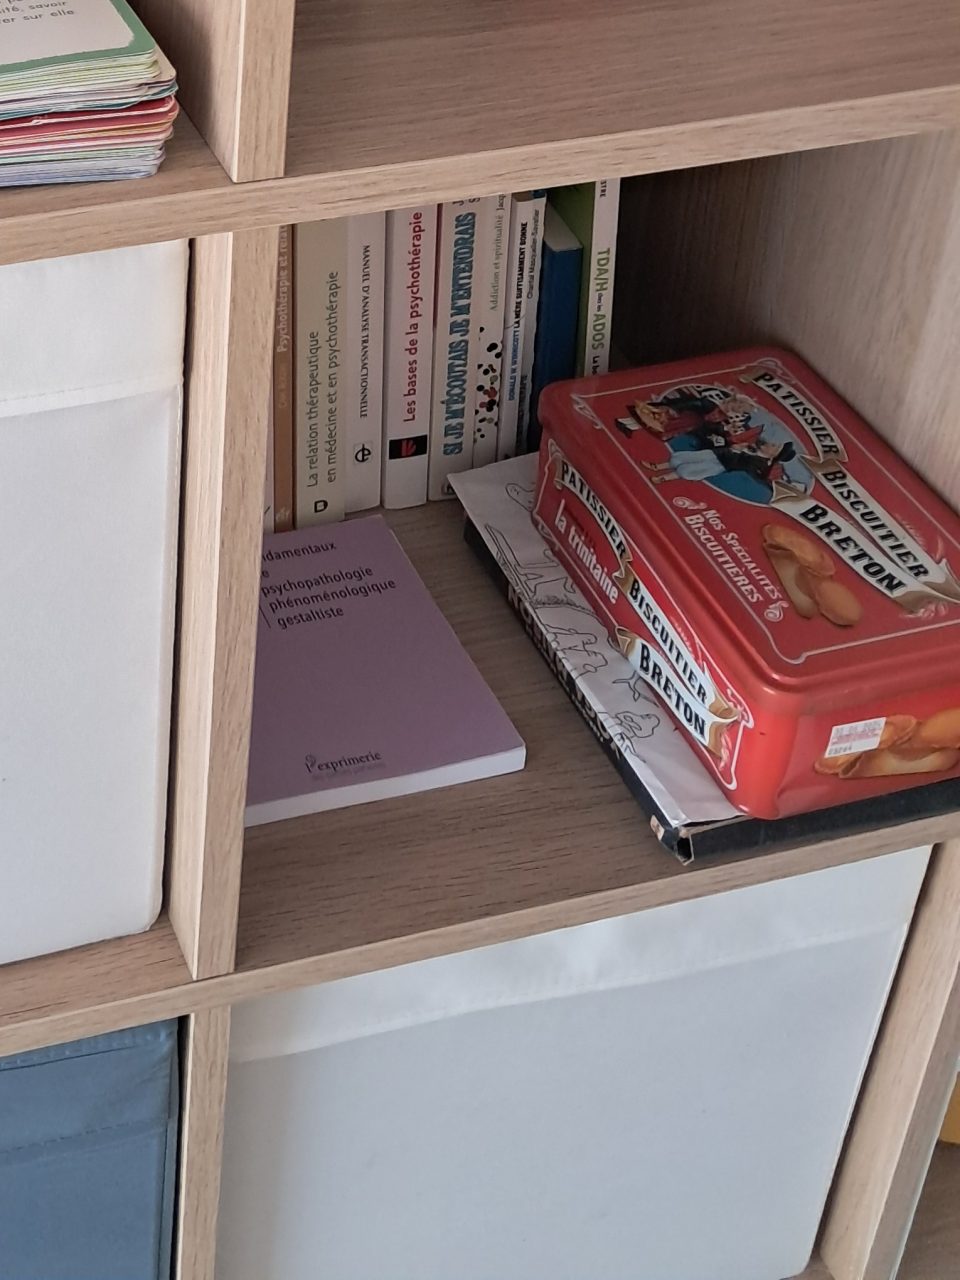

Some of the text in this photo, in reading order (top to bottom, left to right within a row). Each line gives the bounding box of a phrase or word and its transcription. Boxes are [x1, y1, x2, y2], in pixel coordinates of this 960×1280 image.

[23, 13, 44, 21] sur
[28, 1, 68, 10] savoir
[490, 213, 504, 311] Addiction spiritualité
[596, 247, 610, 292] TDA/H
[276, 269, 290, 353] Psychothérapie
[360, 244, 371, 419] MANUEL TRANSACTIONNELLE
[403, 211, 424, 422] Les bases de la psychothérapie
[592, 313, 606, 351] ADOS
[306, 331, 322, 488] La relation thérapeutique
[324, 271, 341, 465] médecine en psychothérapie
[754, 372, 840, 456] PATISSIER
[554, 498, 618, 605] la trinitaine
[560, 464, 626, 559] PATISSIER
[799, 504, 907, 595] BRETON
[823, 469, 929, 578] BISCUITIER
[261, 566, 373, 598] psychopathologie
[269, 579, 396, 613] phénoménologique
[277, 606, 344, 630] gestaltiste
[629, 578, 708, 705] BISCUITIER
[639, 642, 708, 739] BRETON
